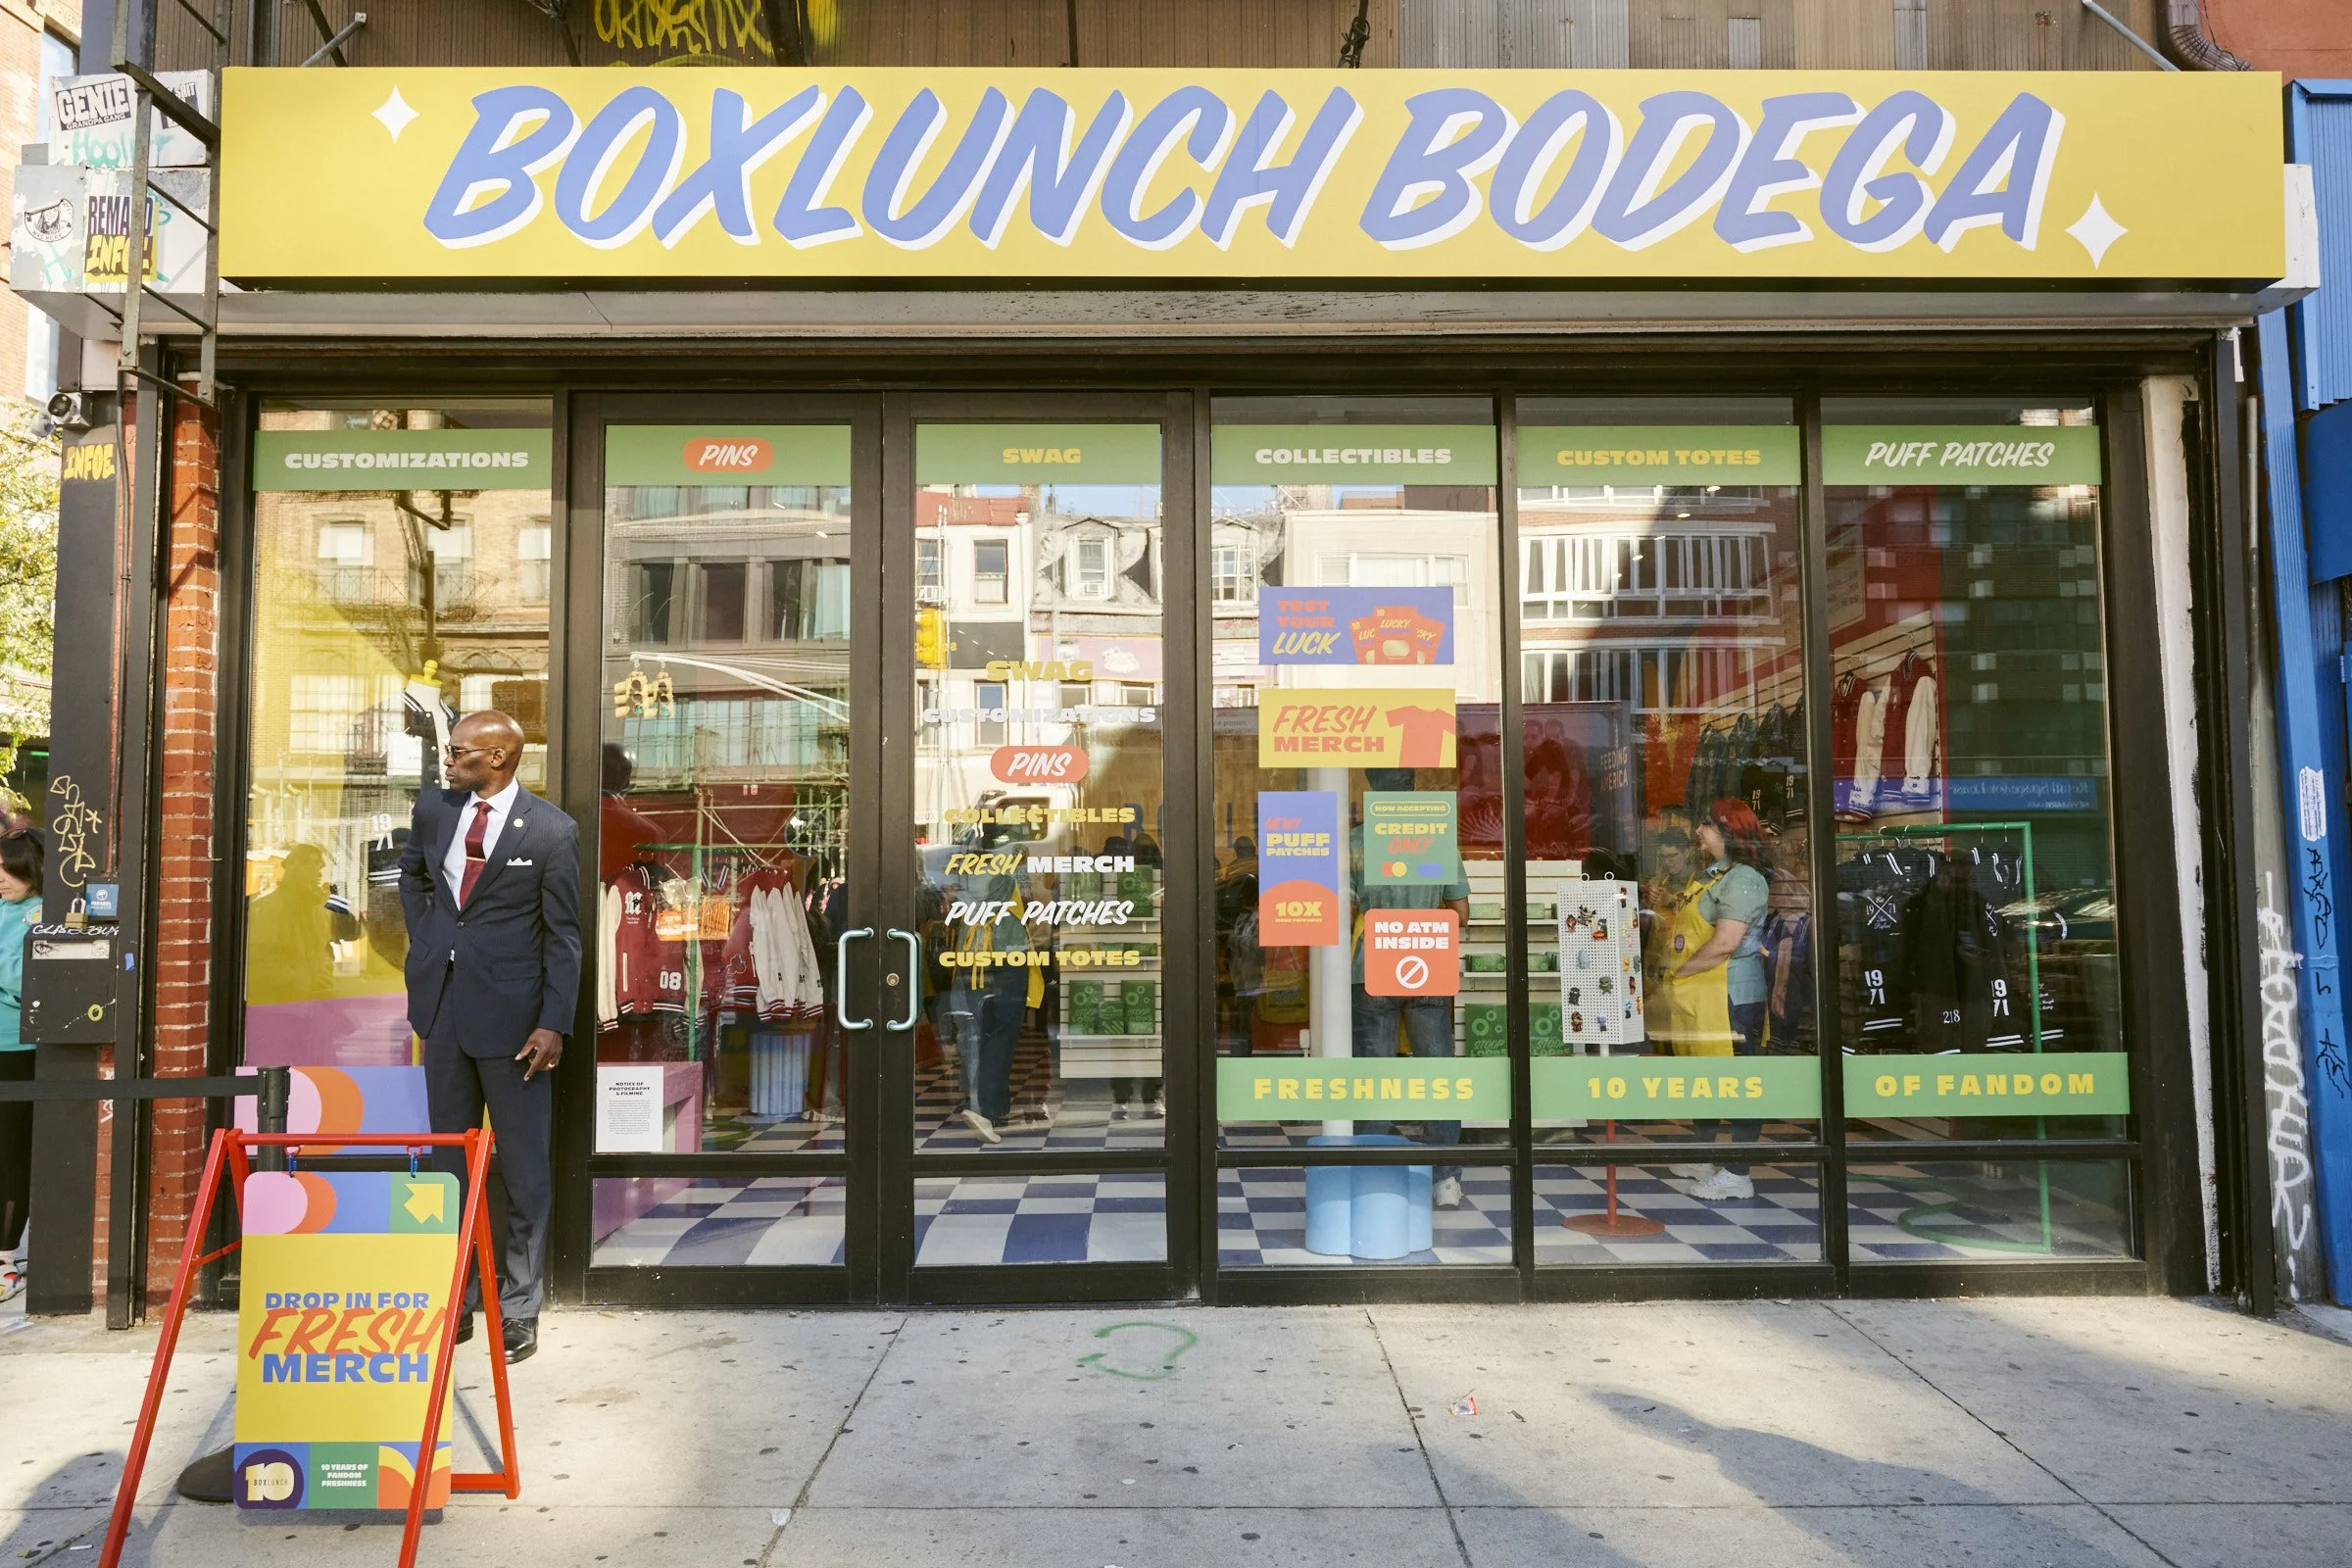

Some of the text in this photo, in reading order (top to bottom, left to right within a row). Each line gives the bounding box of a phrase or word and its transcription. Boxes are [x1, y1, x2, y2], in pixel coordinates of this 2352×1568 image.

[57, 82, 130, 125] GENIE
[66, 113, 126, 129] GRANDPA GANG
[423, 84, 2066, 254] BOXLUNCH BODEGA
[64, 443, 116, 481] INFOE
[284, 451, 529, 469] CUSTOMIZATIONS
[698, 444, 759, 467] PINS
[1002, 448, 1082, 465] SWAG
[1254, 448, 1452, 465] COLLECTIBLES
[1556, 449, 1762, 466] CUSTOM TOTES
[1864, 441, 2056, 468] PUFF PATCHES
[1277, 600, 1331, 612] TEST
[1277, 615, 1336, 629] YOUR
[1380, 618, 1412, 629] LUCKY
[1272, 631, 1342, 656] LUCK
[985, 661, 1094, 682] SWAG
[922, 708, 1156, 723] CUSTOMIZATIONS
[1273, 705, 1378, 734] FRESH
[1273, 736, 1385, 753] MERCH
[1006, 752, 1073, 777] PINS
[371, 813, 392, 832] 19
[944, 808, 1136, 824] COLLECTIBLES
[1374, 822, 1448, 835] CREDIT
[1266, 832, 1331, 847] PUFF
[1387, 836, 1438, 856] ONLY
[1266, 848, 1331, 857] PATCHES
[945, 854, 1135, 876] FRESH MERCH
[944, 900, 1135, 927] PUFF PATCHES
[1275, 902, 1323, 917] 10X
[1375, 921, 1449, 934] NO ATM
[1374, 936, 1449, 950] INSIDE
[939, 951, 1141, 967] CUSTOM TOTES
[660, 970, 682, 991] 08
[1864, 969, 1884, 987] 19
[1870, 988, 1886, 1005] 71
[1992, 1000, 2010, 1017] 71
[1253, 1078, 1475, 1100] FRESHNESS
[1587, 1076, 1764, 1099] 10 YEARS
[1874, 1073, 2094, 1097] OF FANDOM
[266, 1292, 430, 1309] DROP IN FOR
[248, 1306, 447, 1360] FRESH
[263, 1352, 429, 1383] MERCH
[245, 1461, 294, 1501] 10
[253, 1478, 288, 1487] BOXLUNCH
[320, 1479, 368, 1488] FRESHNESS
